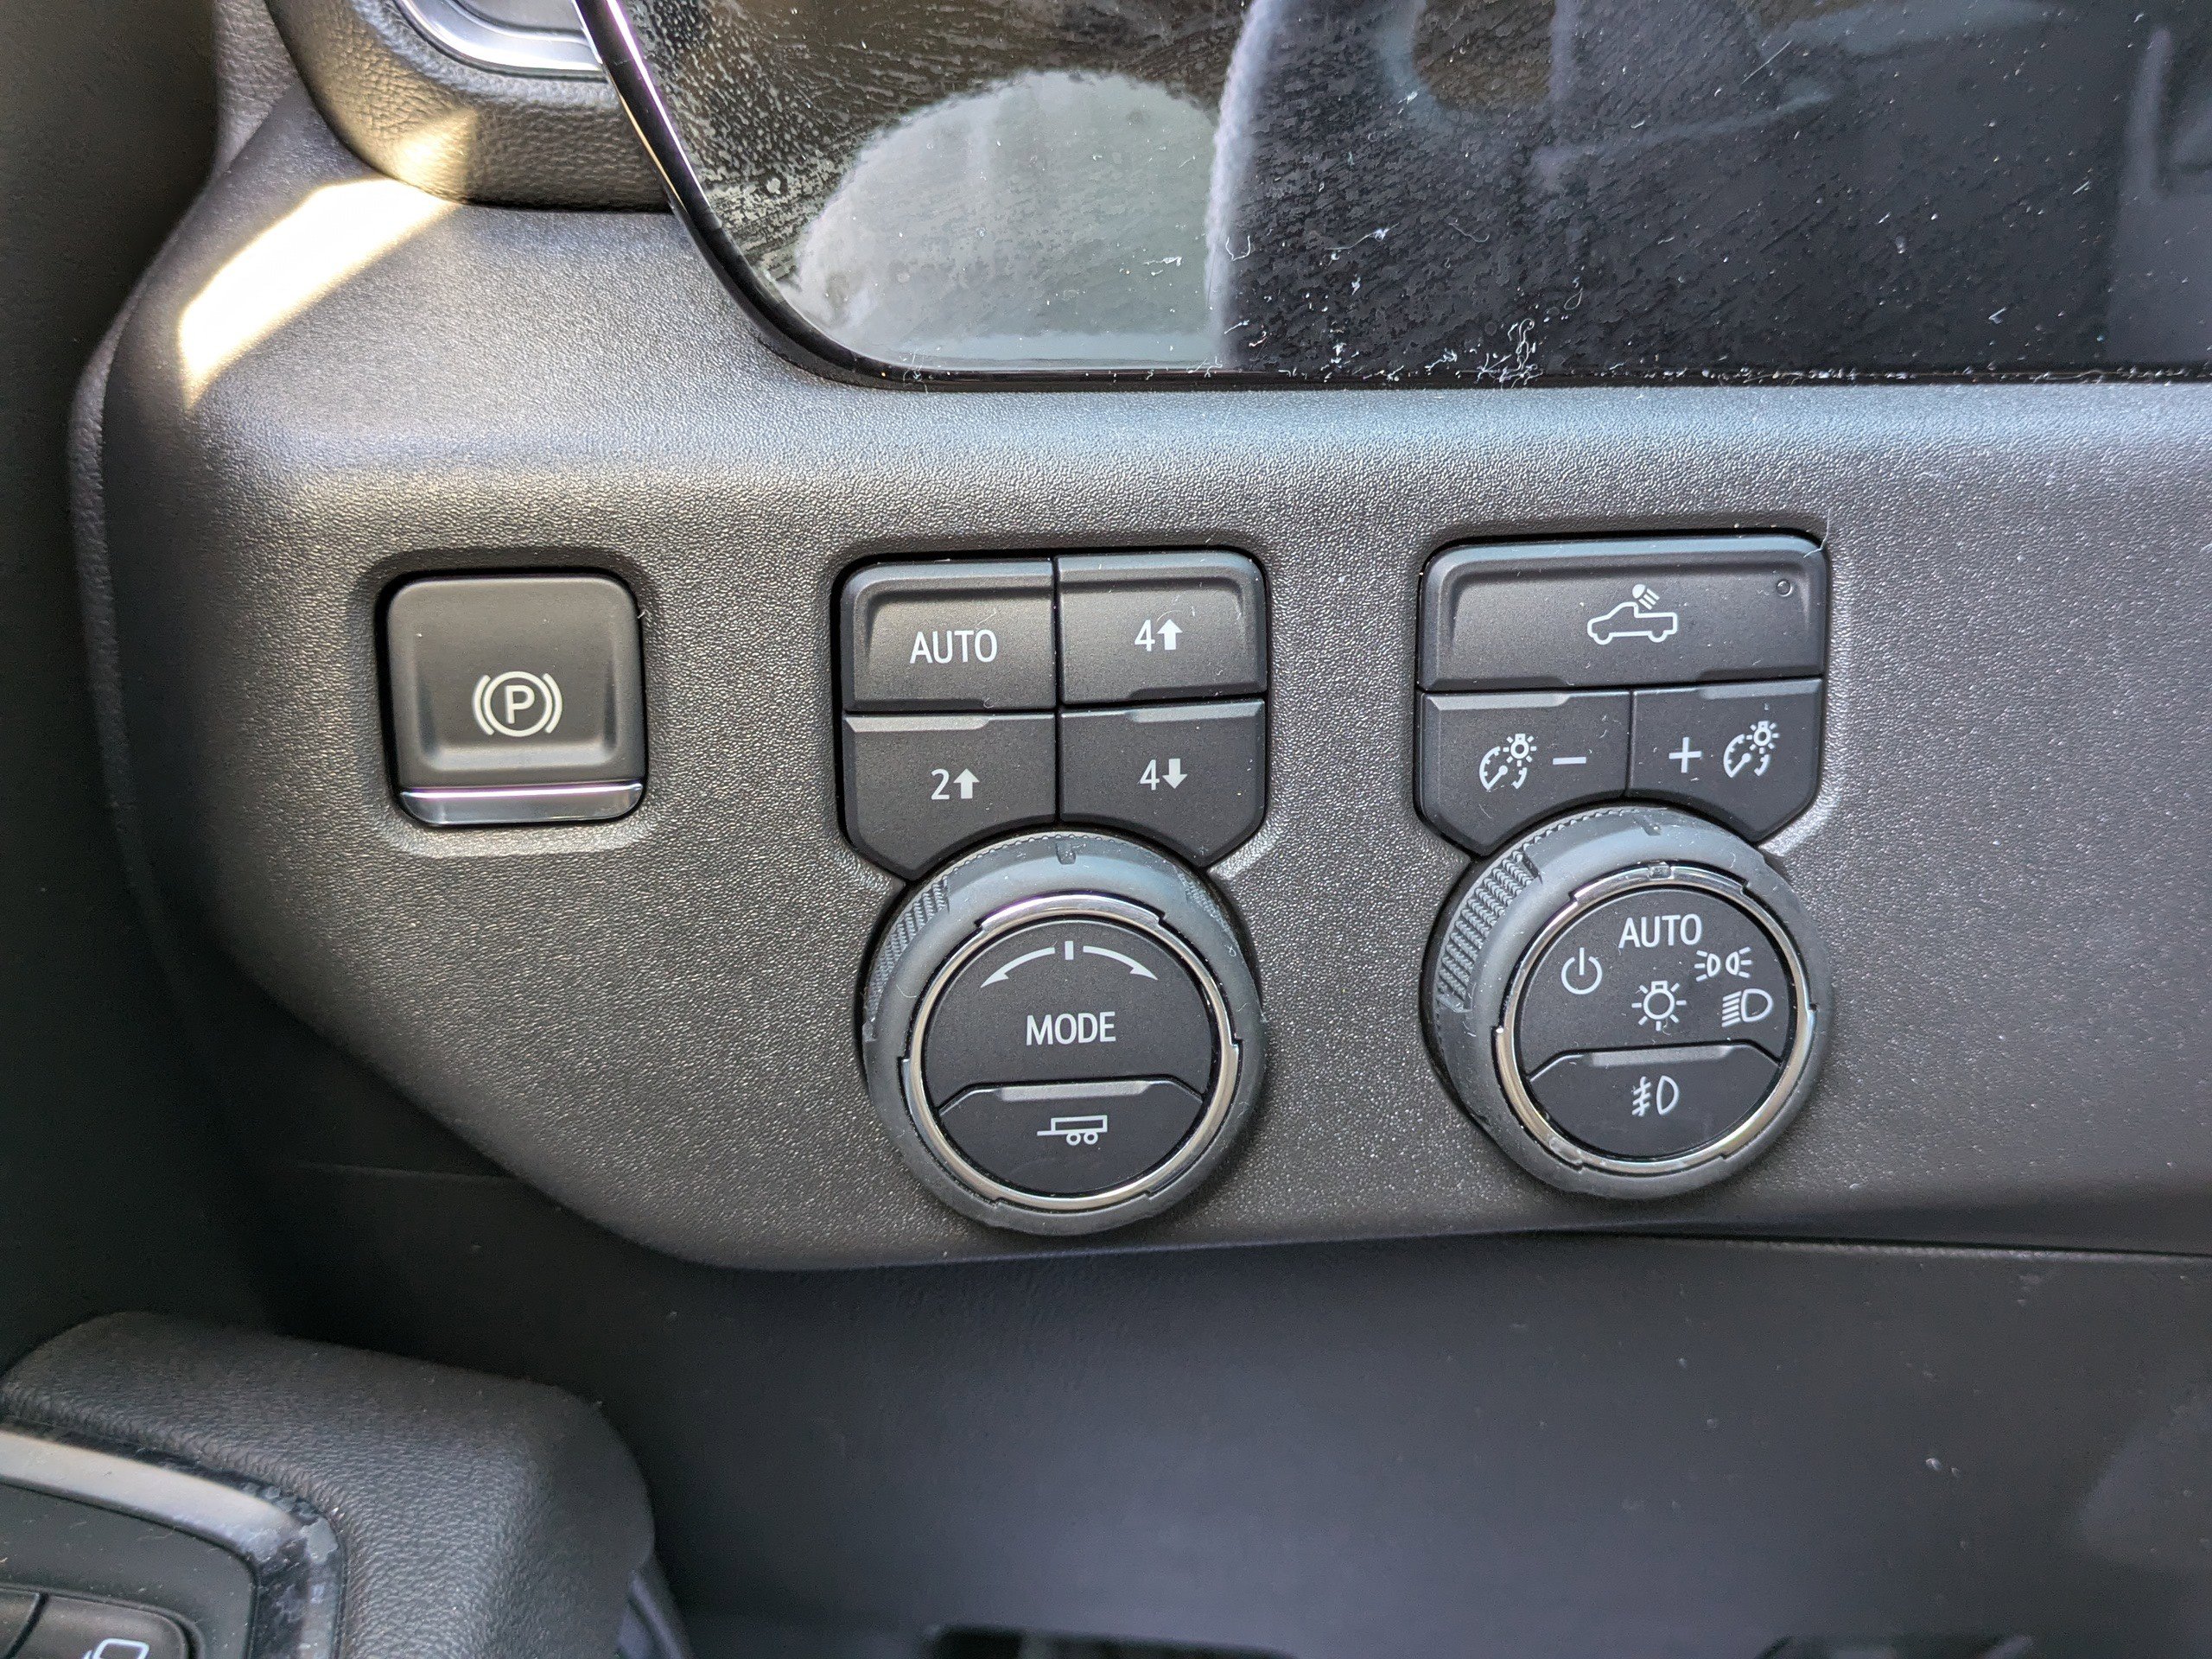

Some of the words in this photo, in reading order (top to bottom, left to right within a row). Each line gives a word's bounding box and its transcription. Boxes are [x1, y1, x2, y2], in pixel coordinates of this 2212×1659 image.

[909, 629, 998, 664] AUTO
[1134, 620, 1156, 652] 4
[503, 684, 536, 726] P
[931, 767, 950, 801] 2
[1139, 759, 1160, 791] 4
[1618, 912, 1703, 950] AUTO
[1026, 1010, 1116, 1046] MODE
